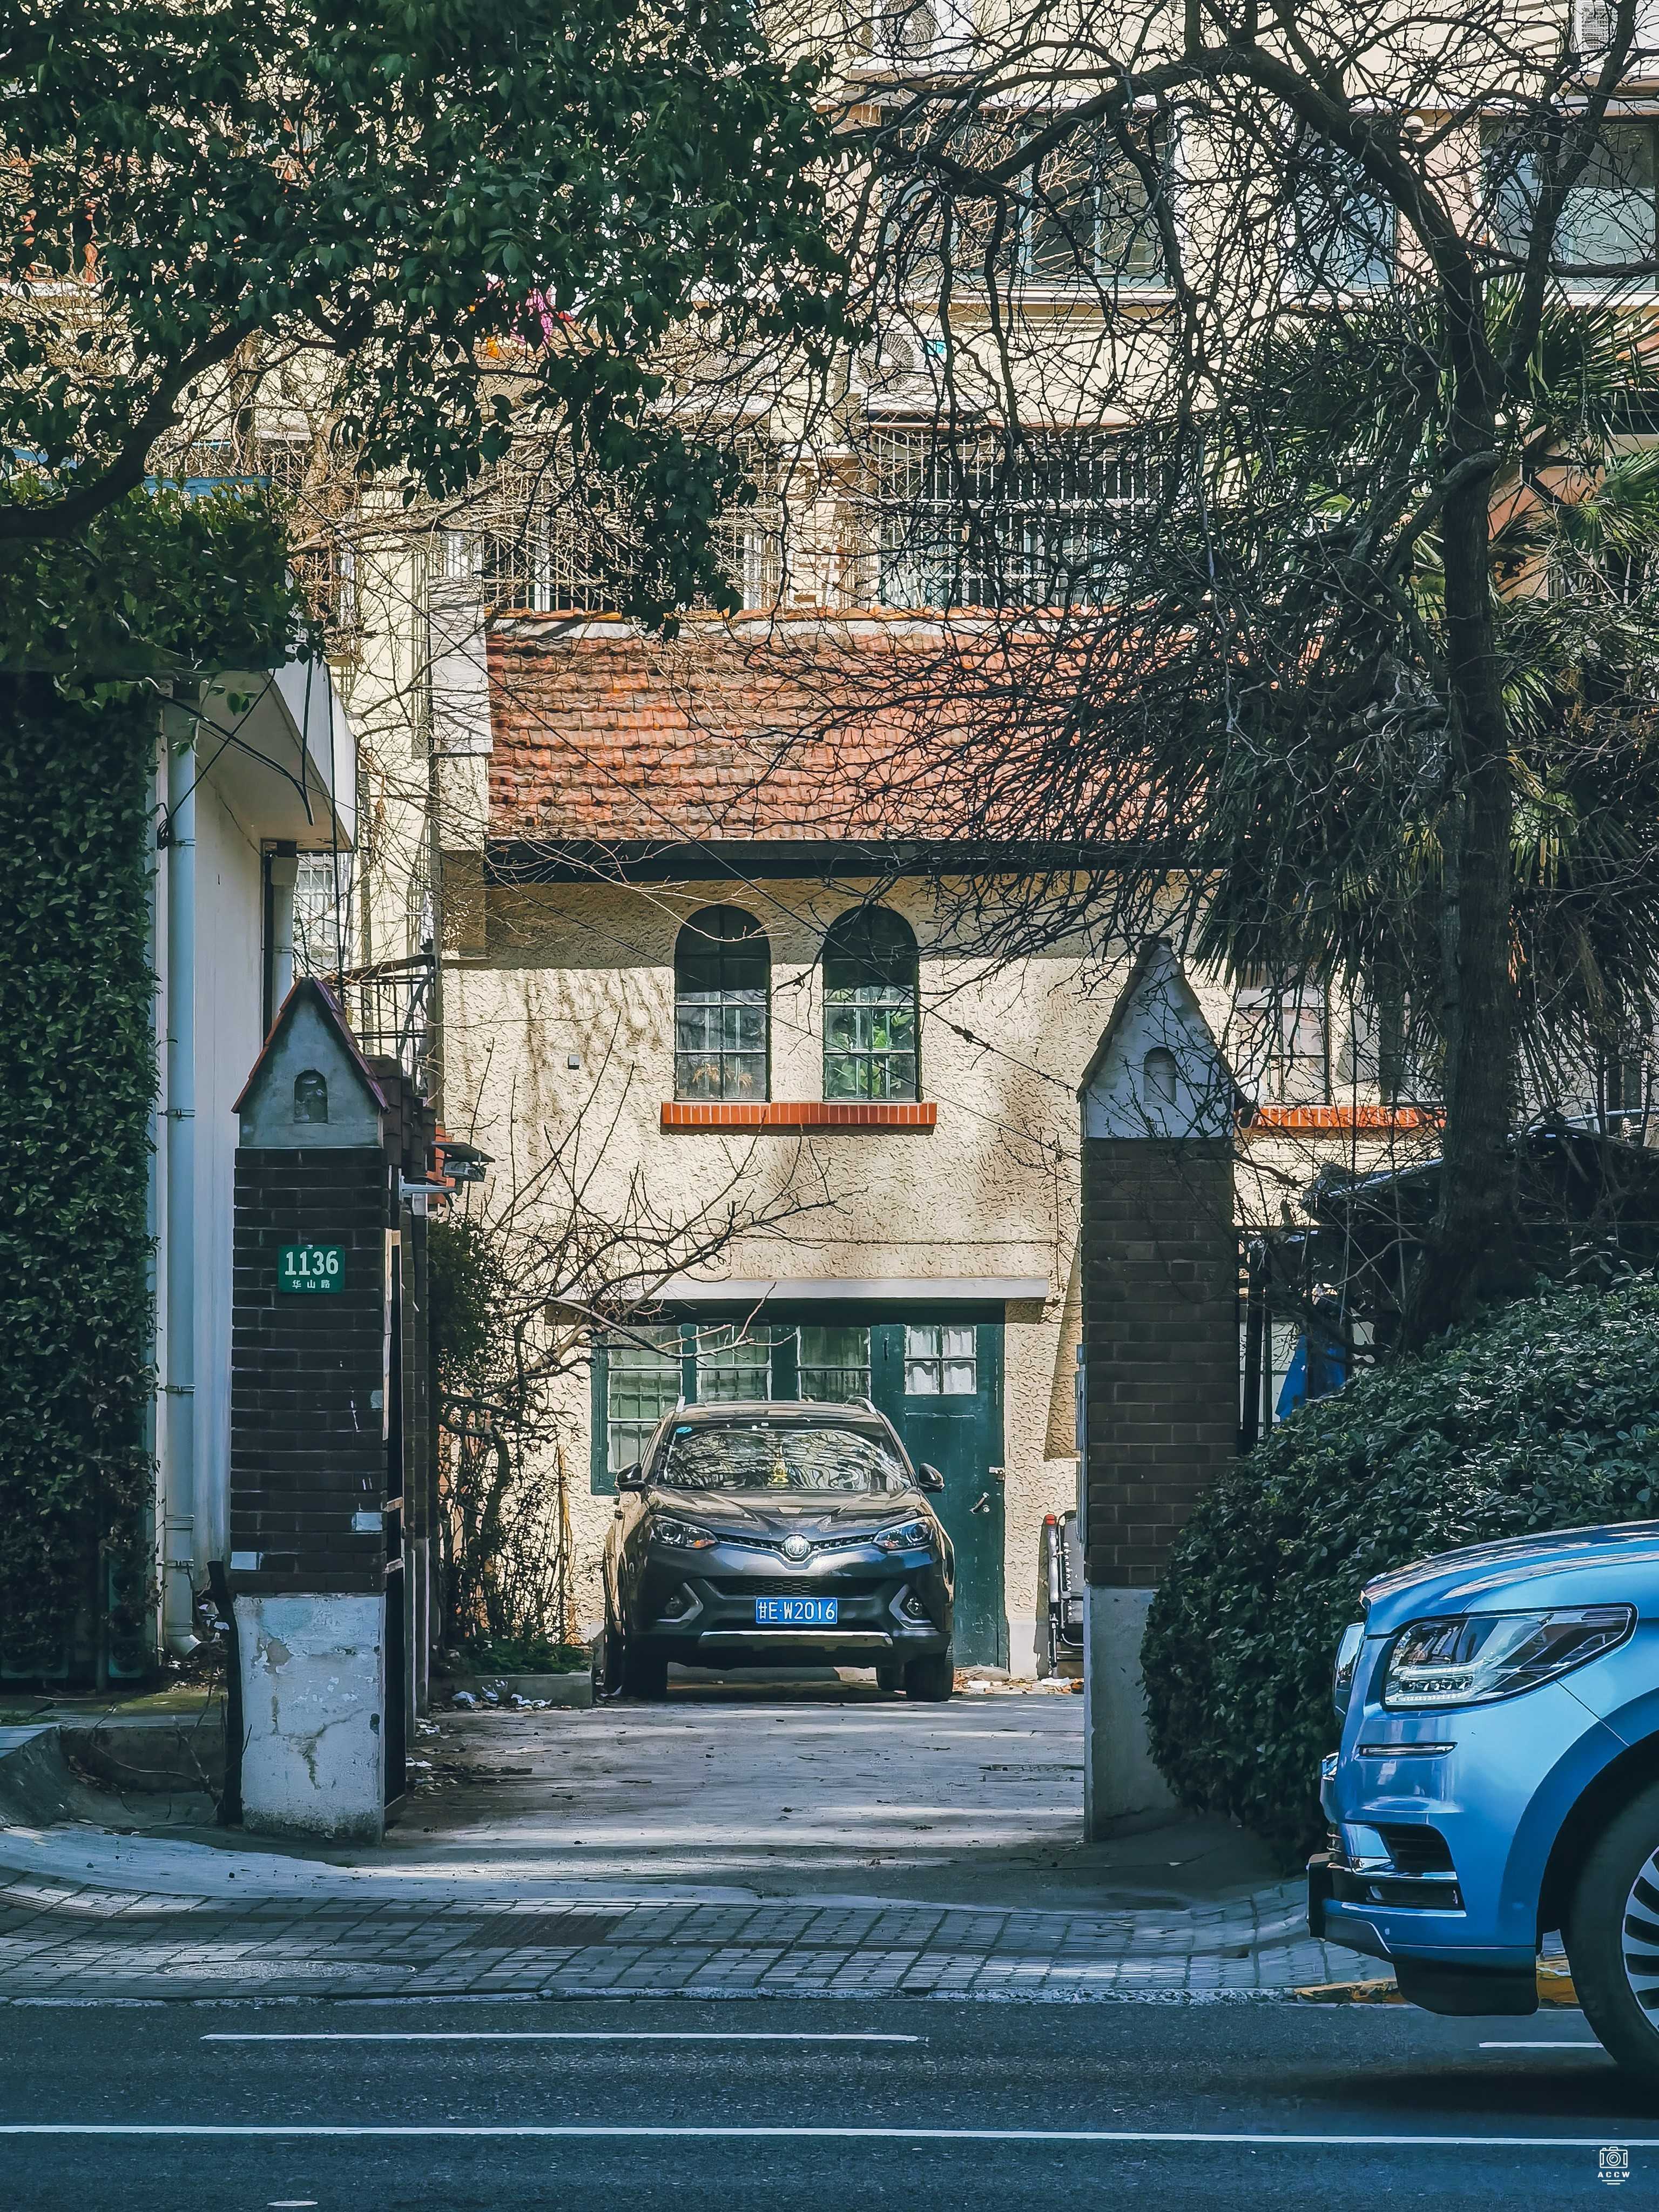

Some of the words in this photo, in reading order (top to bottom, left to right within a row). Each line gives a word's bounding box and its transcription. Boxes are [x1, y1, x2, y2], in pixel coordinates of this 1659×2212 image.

[285, 1251, 339, 1275] 1136
[292, 1279, 330, 1289] 华山路
